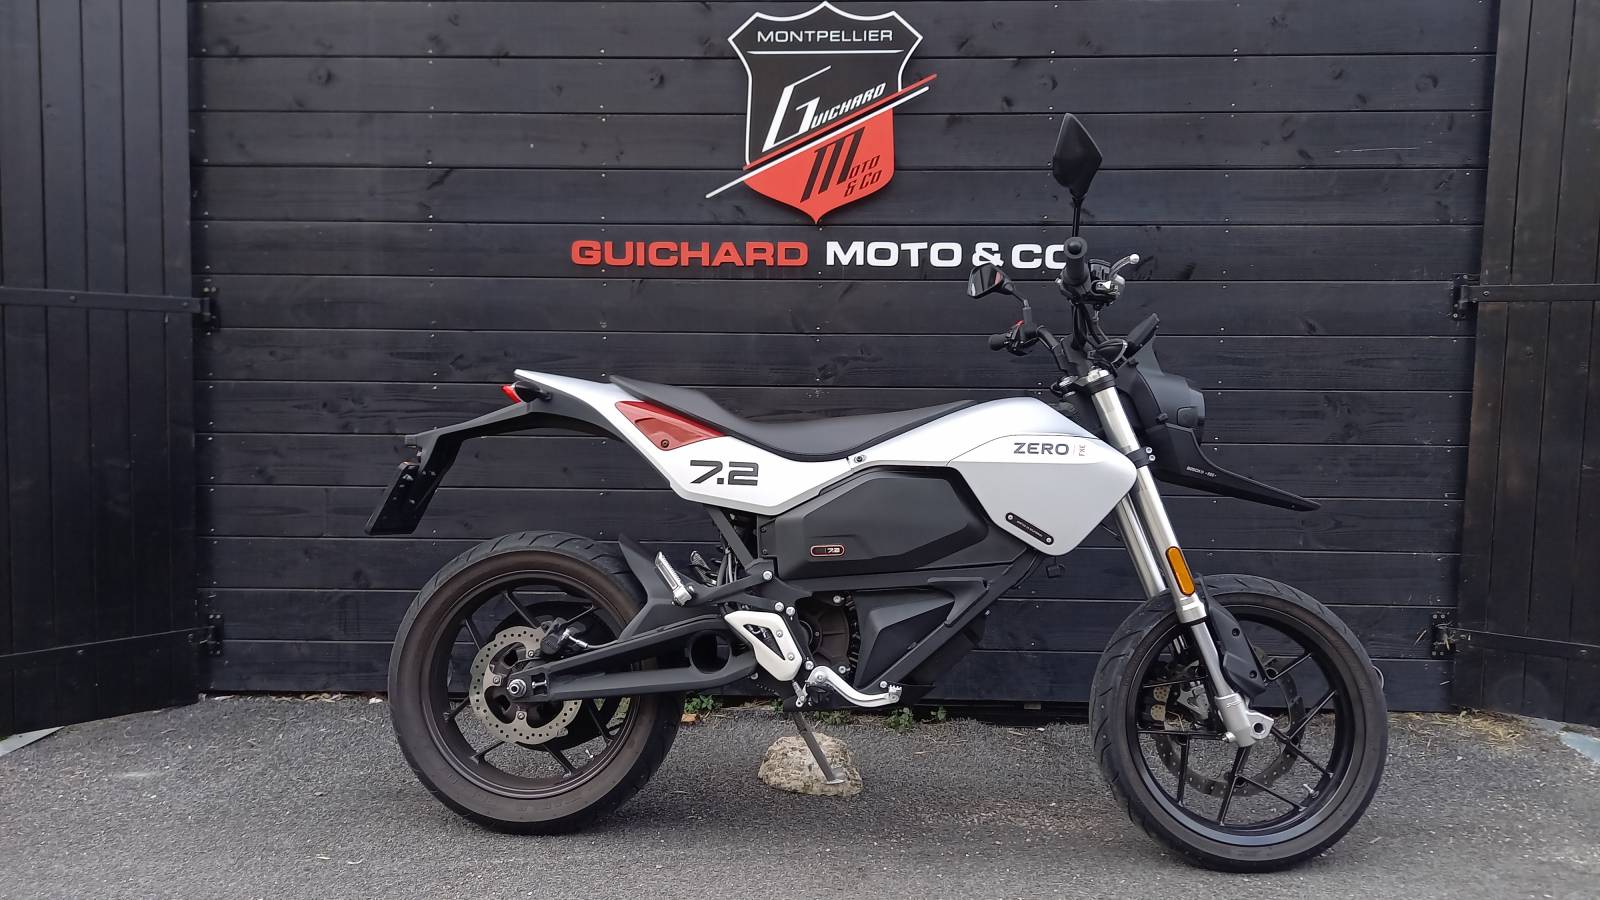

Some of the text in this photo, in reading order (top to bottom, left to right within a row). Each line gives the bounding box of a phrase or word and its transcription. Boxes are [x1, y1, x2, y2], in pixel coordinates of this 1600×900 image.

[757, 30, 893, 43] MONTPELLIER
[762, 65, 886, 152] GUICHARD
[843, 182, 856, 197] &
[571, 240, 809, 267] GUICHARD
[826, 240, 962, 267] MOTO
[972, 241, 1004, 267] &
[1013, 442, 1069, 455] ZERO
[690, 459, 759, 486] 7.2
